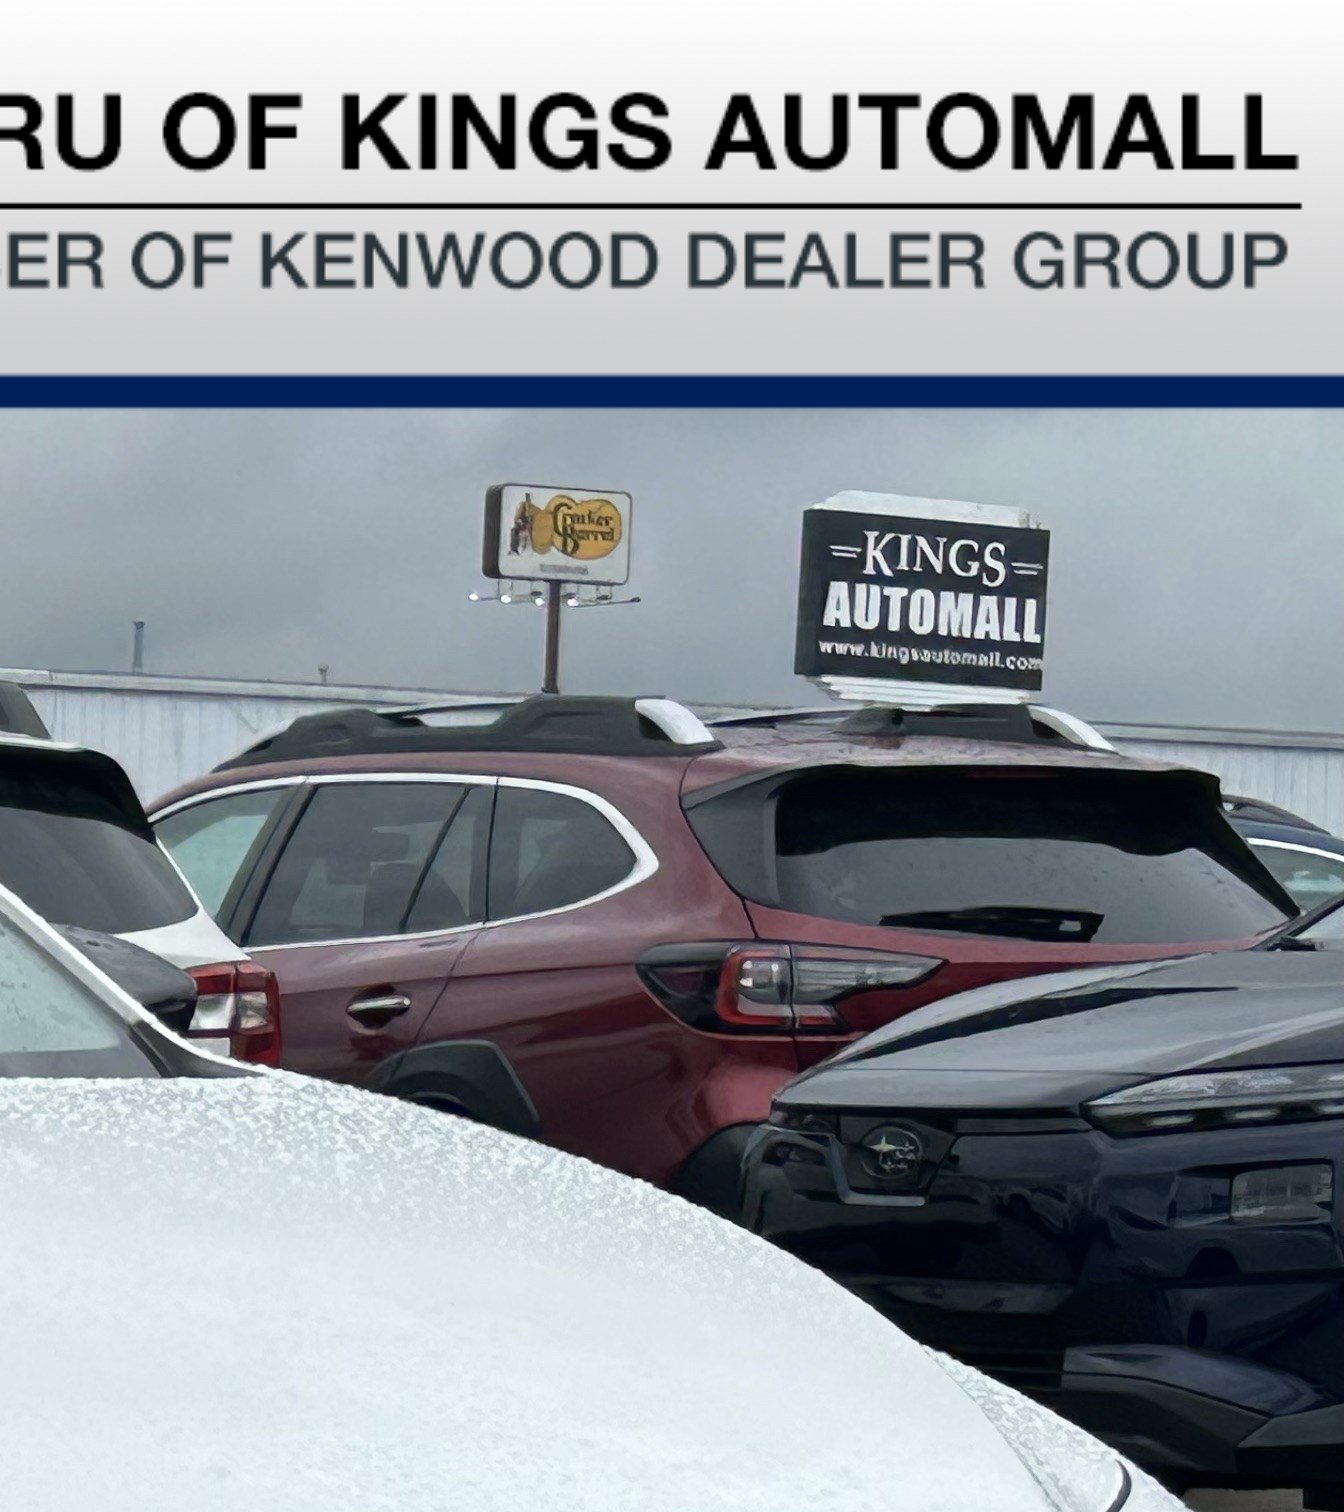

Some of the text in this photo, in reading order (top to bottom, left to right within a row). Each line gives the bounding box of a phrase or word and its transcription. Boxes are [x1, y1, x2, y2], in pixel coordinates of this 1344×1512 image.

[861, 529, 1007, 587] KINGS
[822, 580, 1042, 644] AUTOMALL
[818, 639, 1044, 672] www.kingsautomall.com
